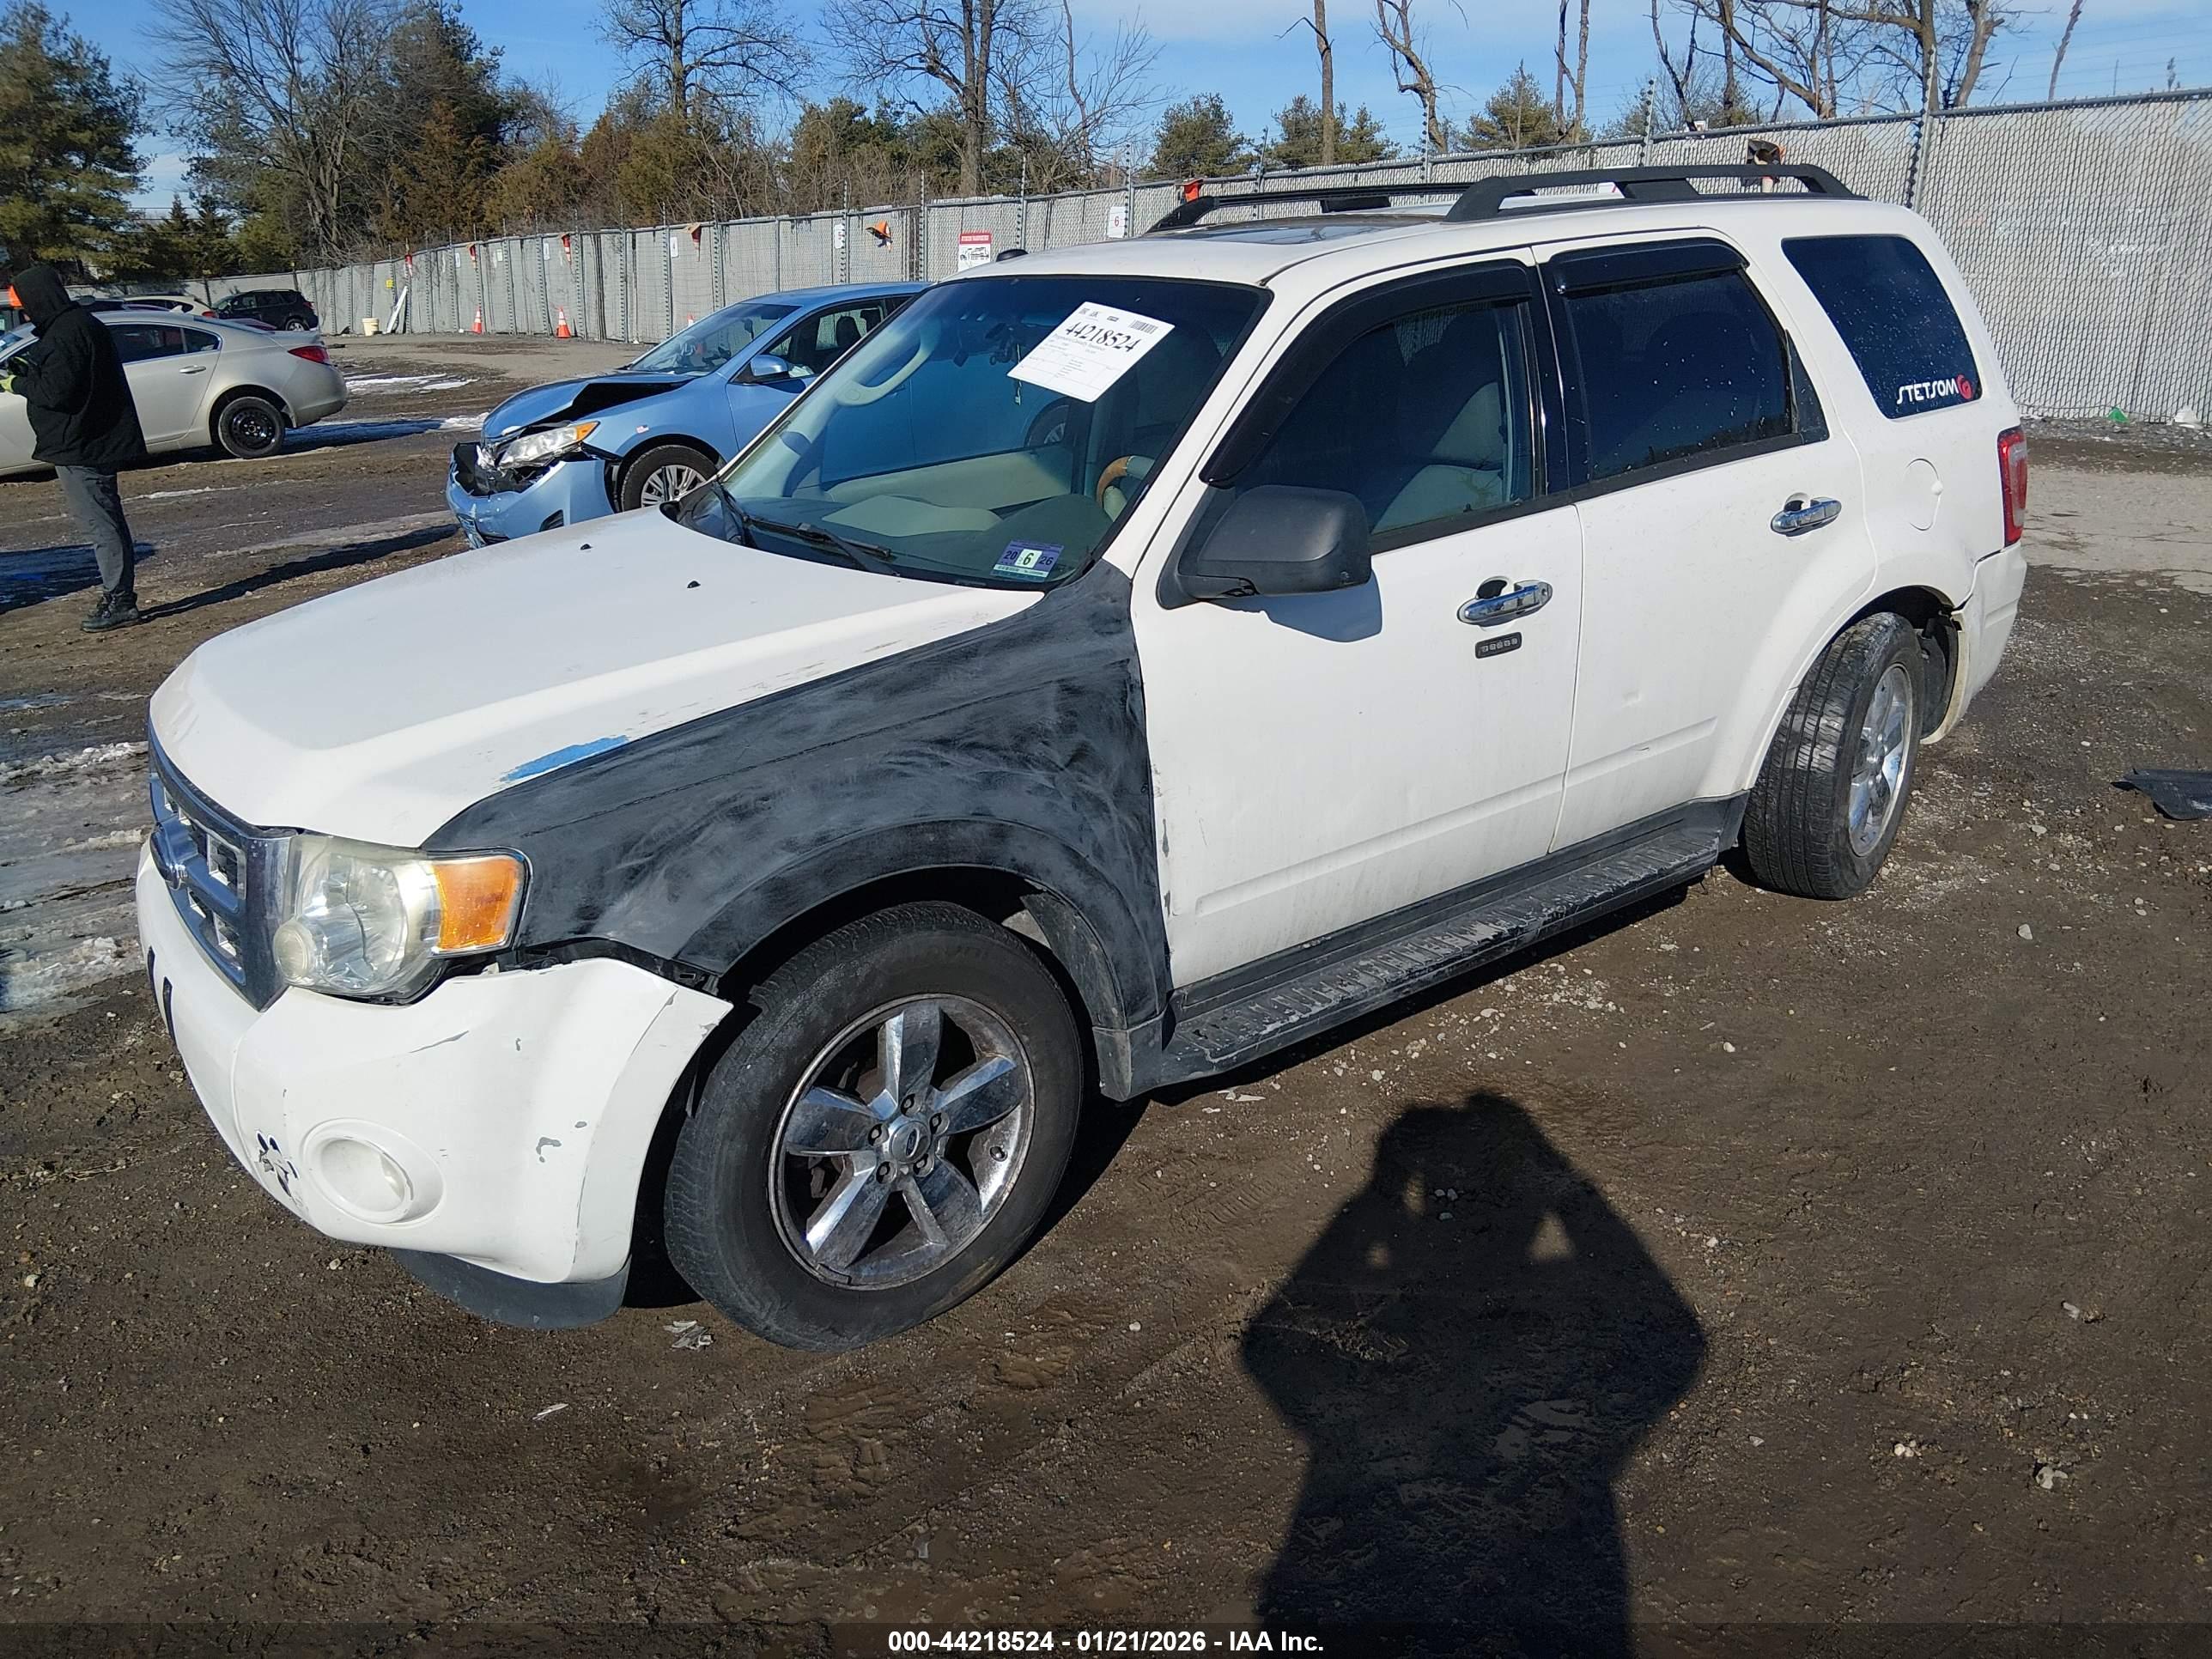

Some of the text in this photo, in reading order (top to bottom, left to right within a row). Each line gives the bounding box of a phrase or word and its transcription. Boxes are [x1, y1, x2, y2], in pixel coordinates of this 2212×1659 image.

[1066, 321, 1142, 353] 44218524
[1896, 378, 1959, 404] STETSOM
[1003, 550, 1018, 560] 20
[1023, 552, 1034, 566] 6
[1039, 556, 1054, 565] 26
